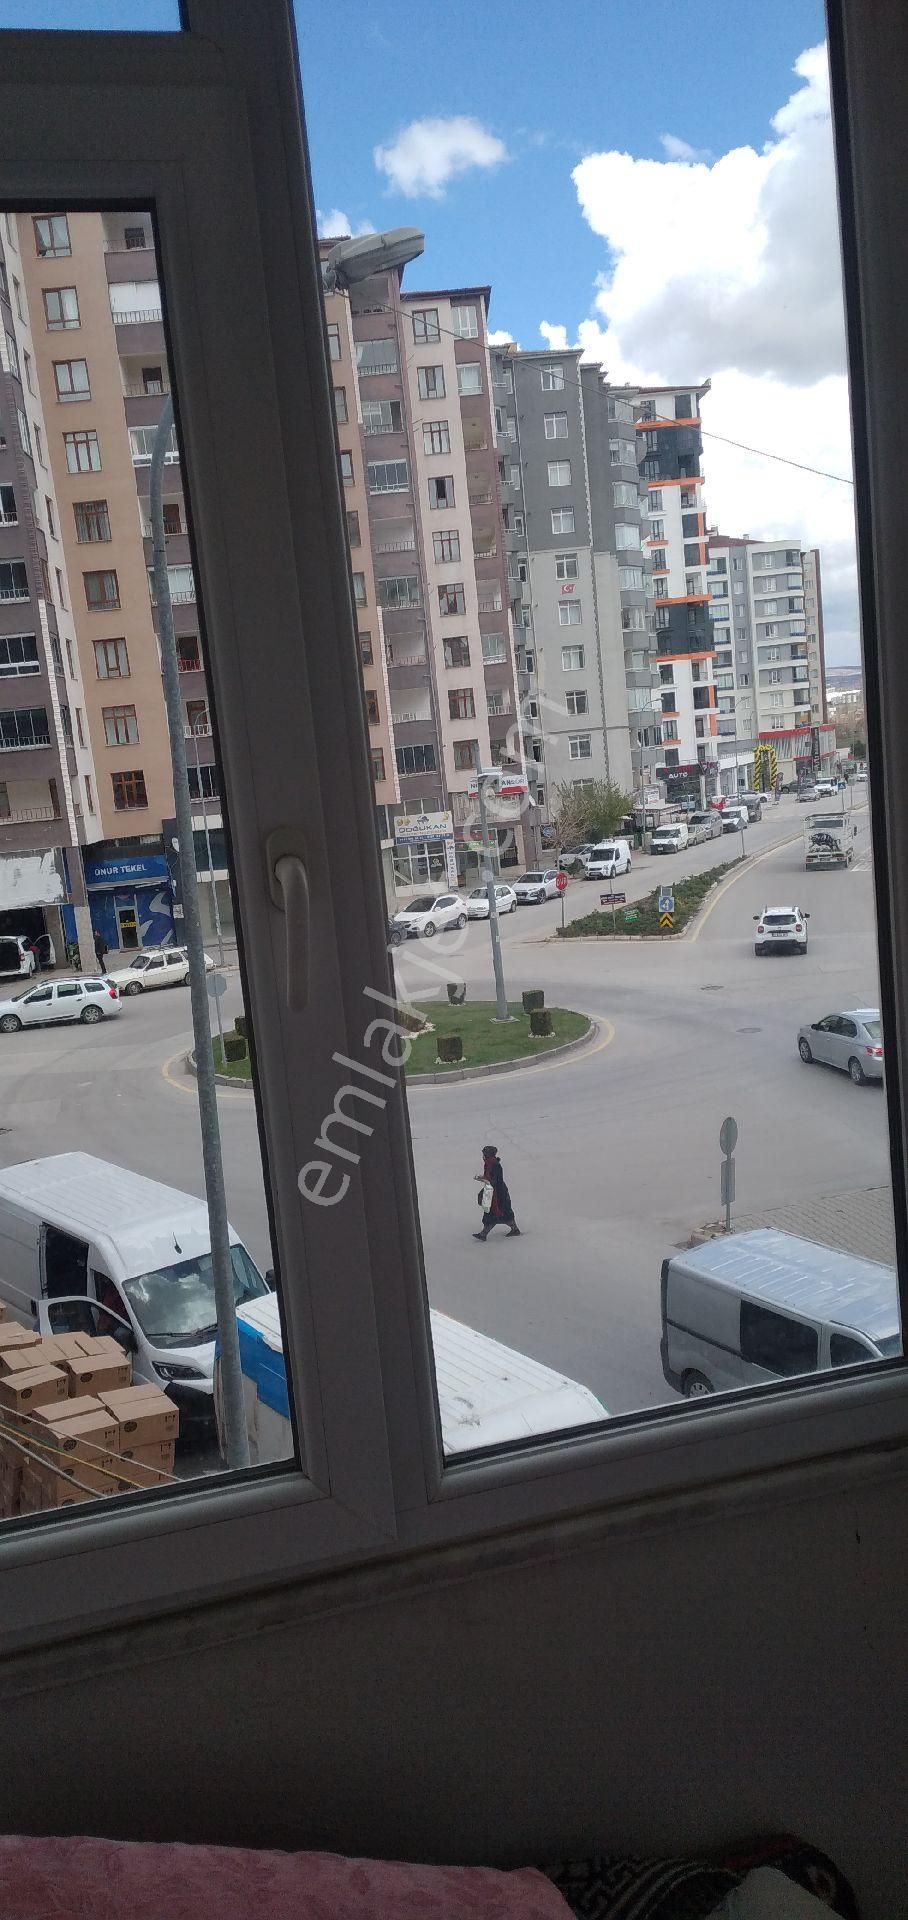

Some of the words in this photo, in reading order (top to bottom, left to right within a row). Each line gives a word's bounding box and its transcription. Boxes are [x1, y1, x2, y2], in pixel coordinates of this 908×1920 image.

[398, 823, 447, 834] DOĞUKAN
[94, 867, 118, 876] ONUR
[120, 864, 147, 873] TEKEL
